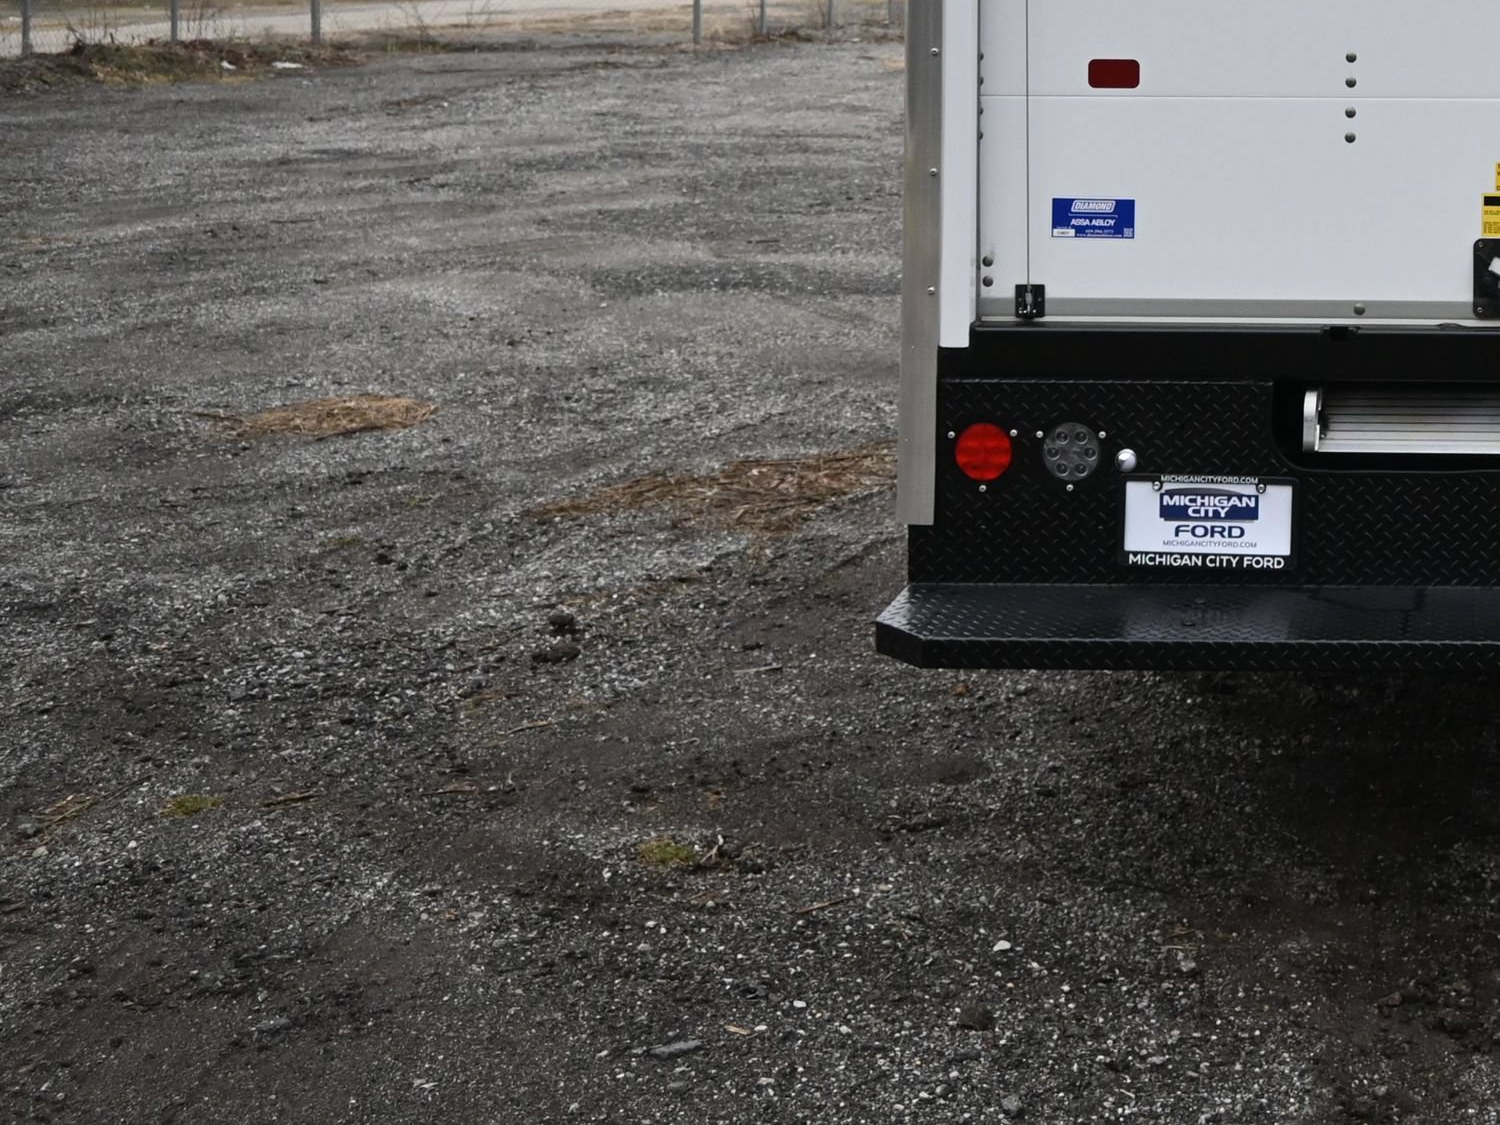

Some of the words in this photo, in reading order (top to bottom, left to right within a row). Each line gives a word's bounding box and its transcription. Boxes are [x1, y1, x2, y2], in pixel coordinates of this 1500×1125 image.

[1074, 201, 1112, 211] DIAMOND
[1070, 218, 1090, 226] ASSA
[1160, 475, 1258, 484] MICHIGANCITYFORD.COM
[1162, 495, 1256, 507] MICHIGAN
[1187, 507, 1230, 518] CITY
[1174, 525, 1245, 539] FORD
[1162, 540, 1257, 548] MICHIGANCITYFORD.COM
[1128, 553, 1202, 567] MICHIGAN
[1206, 555, 1240, 568] CITY
[1243, 556, 1285, 569] FORD
